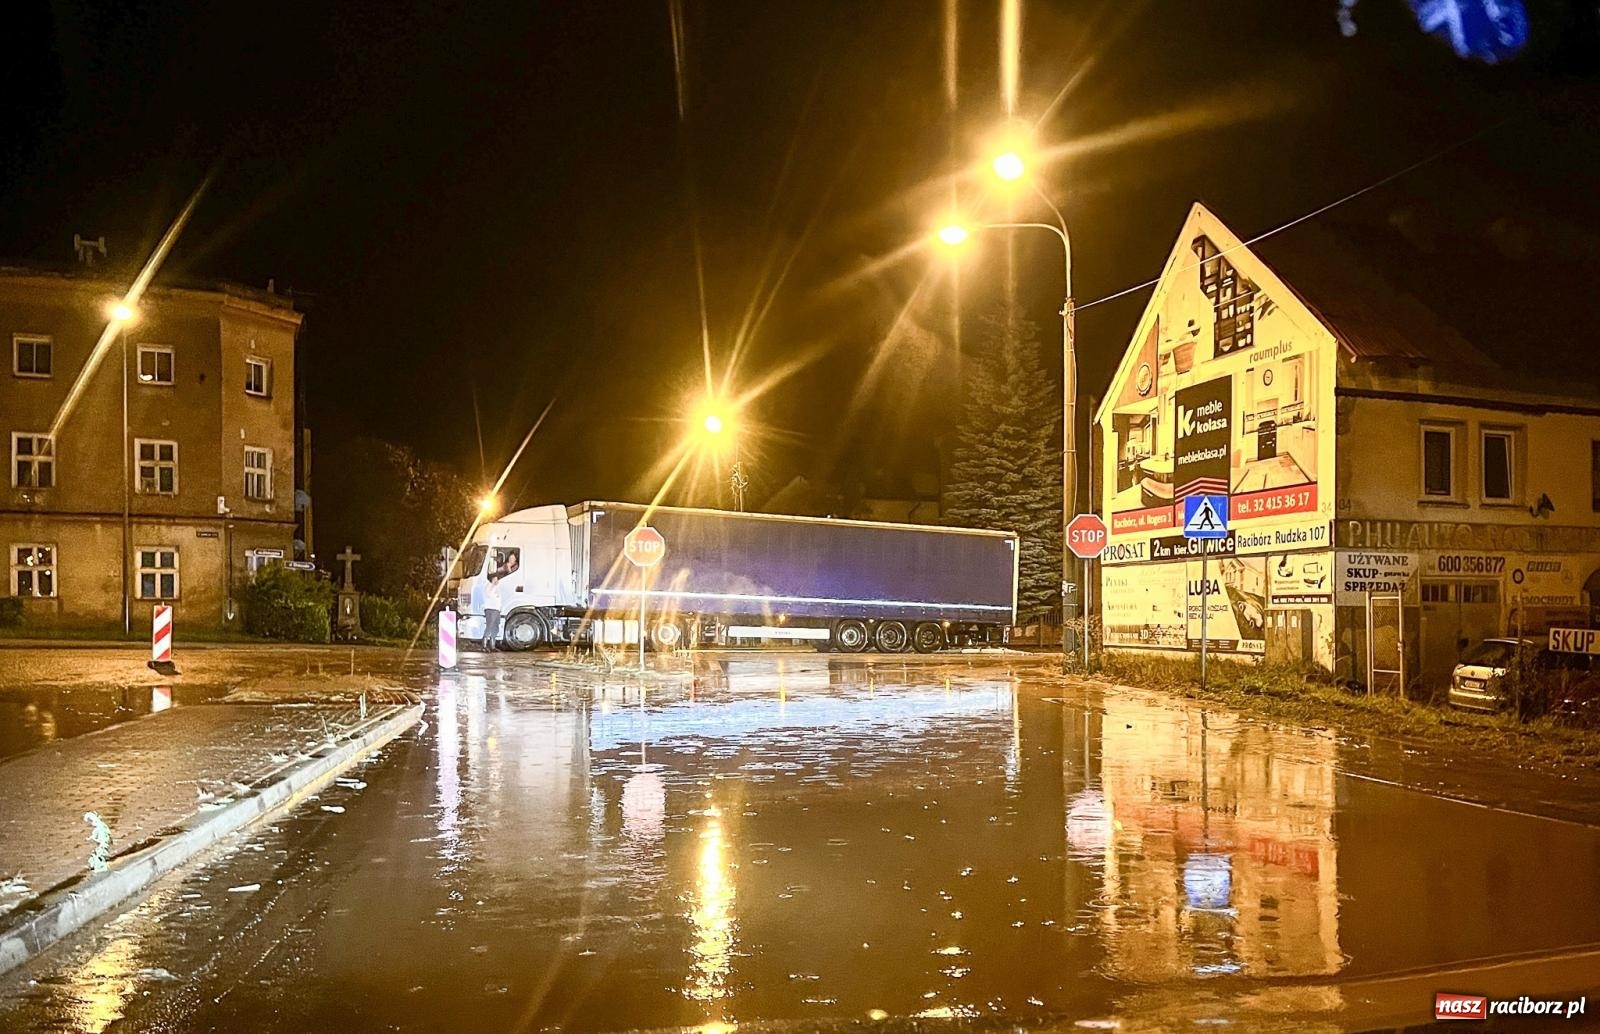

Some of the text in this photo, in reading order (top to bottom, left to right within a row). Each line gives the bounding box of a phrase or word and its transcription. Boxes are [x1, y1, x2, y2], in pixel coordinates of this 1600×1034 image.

[1250, 340, 1293, 363] raumplus
[1196, 400, 1223, 417] meble
[1196, 417, 1228, 434] kolasa
[1177, 444, 1227, 465] meblekolasa.pl
[1237, 492, 1310, 513] tel. 32 415 36 17
[1072, 529, 1104, 543] STOP
[1237, 526, 1326, 548] Racibórz Rudzka 107
[629, 540, 661, 553] STOP
[1103, 541, 1146, 560] PROSAT
[1348, 552, 1409, 566] UŻYWANE
[1188, 579, 1221, 596] LUBA
[1344, 580, 1407, 592] SPRZEDAŻ
[1552, 630, 1595, 652] SKUP
